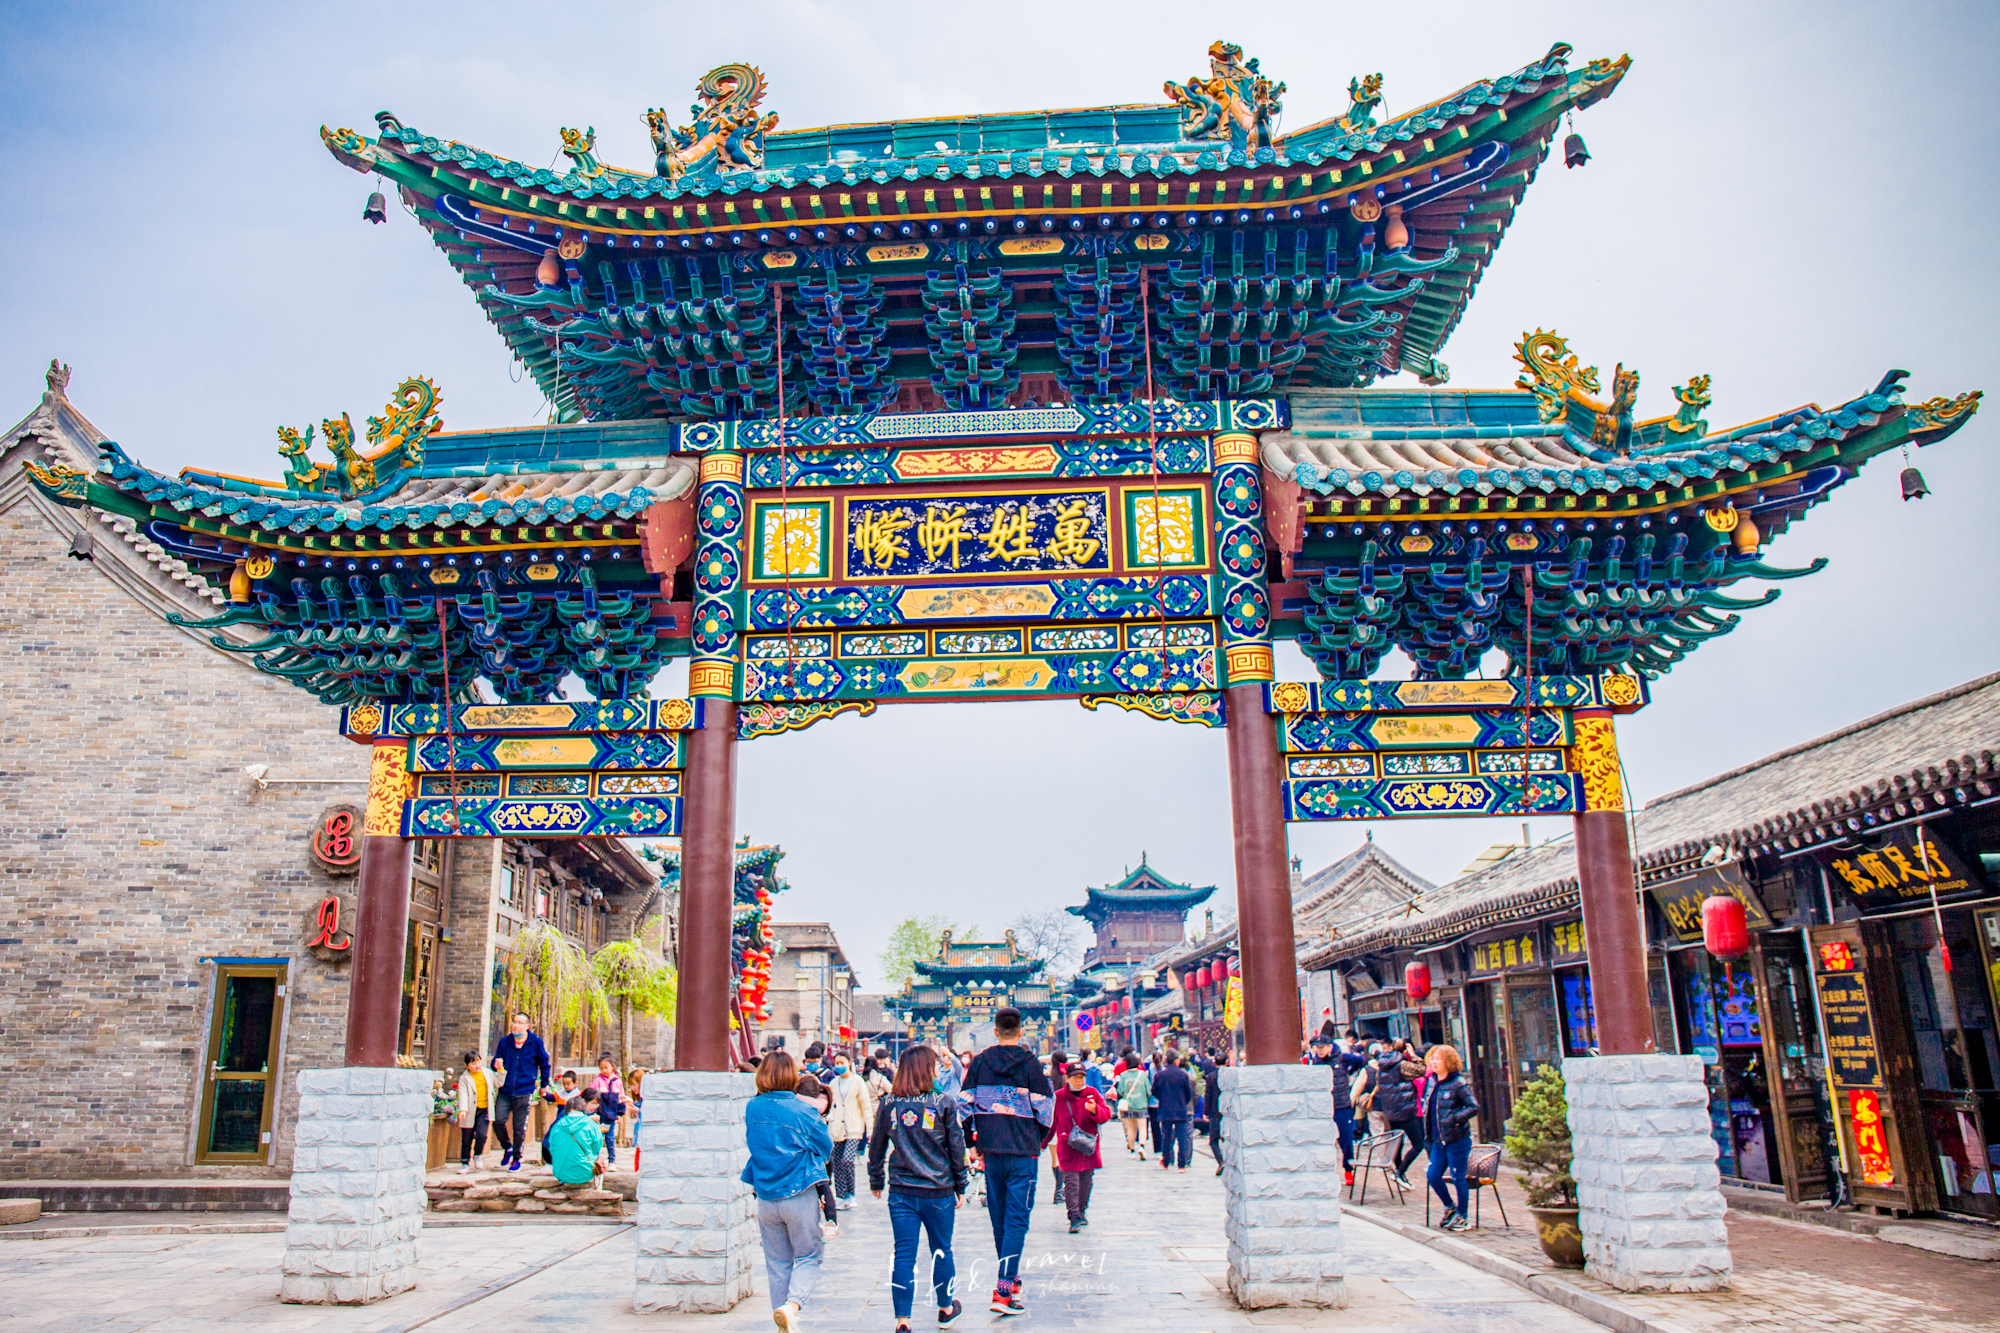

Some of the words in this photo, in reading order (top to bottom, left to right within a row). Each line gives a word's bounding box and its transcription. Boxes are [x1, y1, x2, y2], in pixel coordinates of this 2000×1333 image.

[307, 811, 362, 950] 遇见
[1831, 840, 1952, 894] 张师足疗
[1474, 935, 1534, 971] 山西面食
